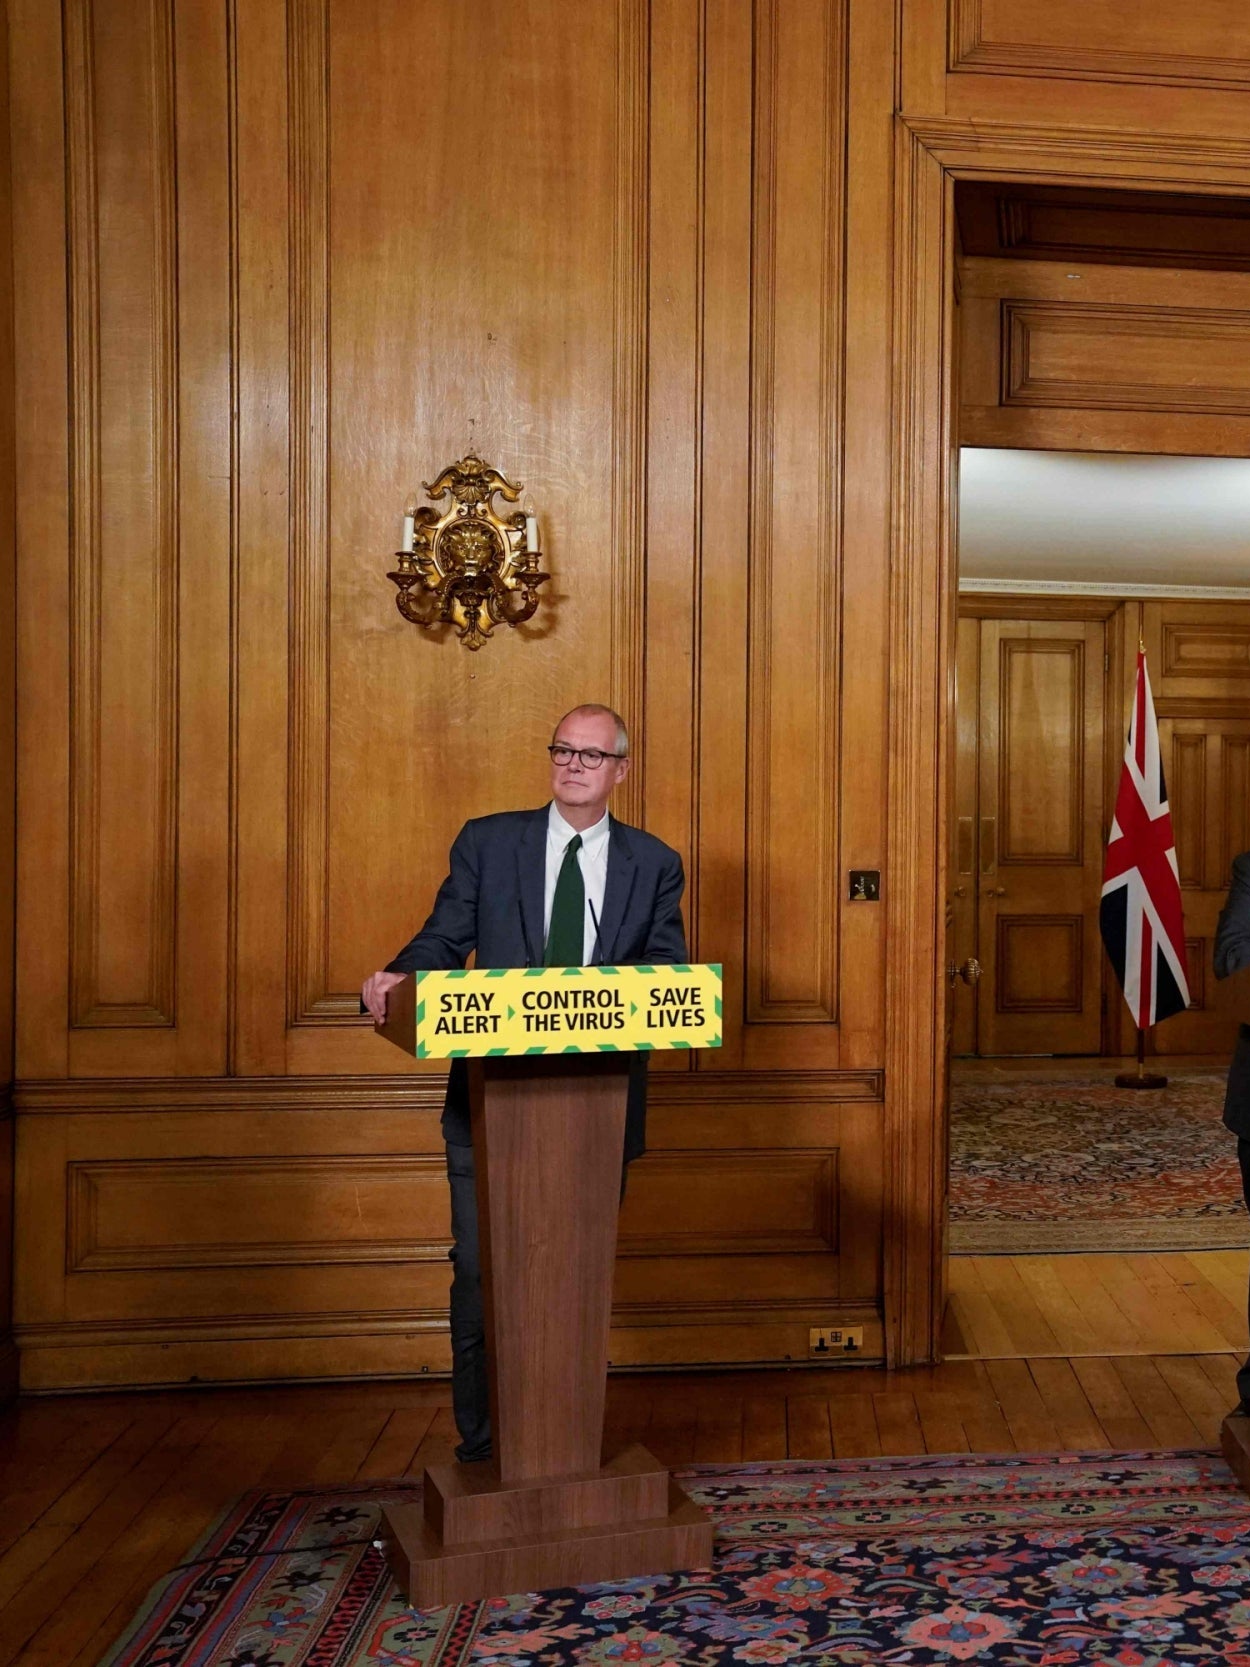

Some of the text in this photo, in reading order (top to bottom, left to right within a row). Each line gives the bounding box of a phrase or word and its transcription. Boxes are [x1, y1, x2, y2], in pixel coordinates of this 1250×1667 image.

[440, 992, 496, 1013] STAY
[521, 988, 625, 1010] CONTROL
[648, 986, 702, 1007] SAVE
[434, 1014, 502, 1035] ALERT
[522, 1011, 626, 1033] THE VIRUS
[645, 1008, 706, 1029] LIVES
